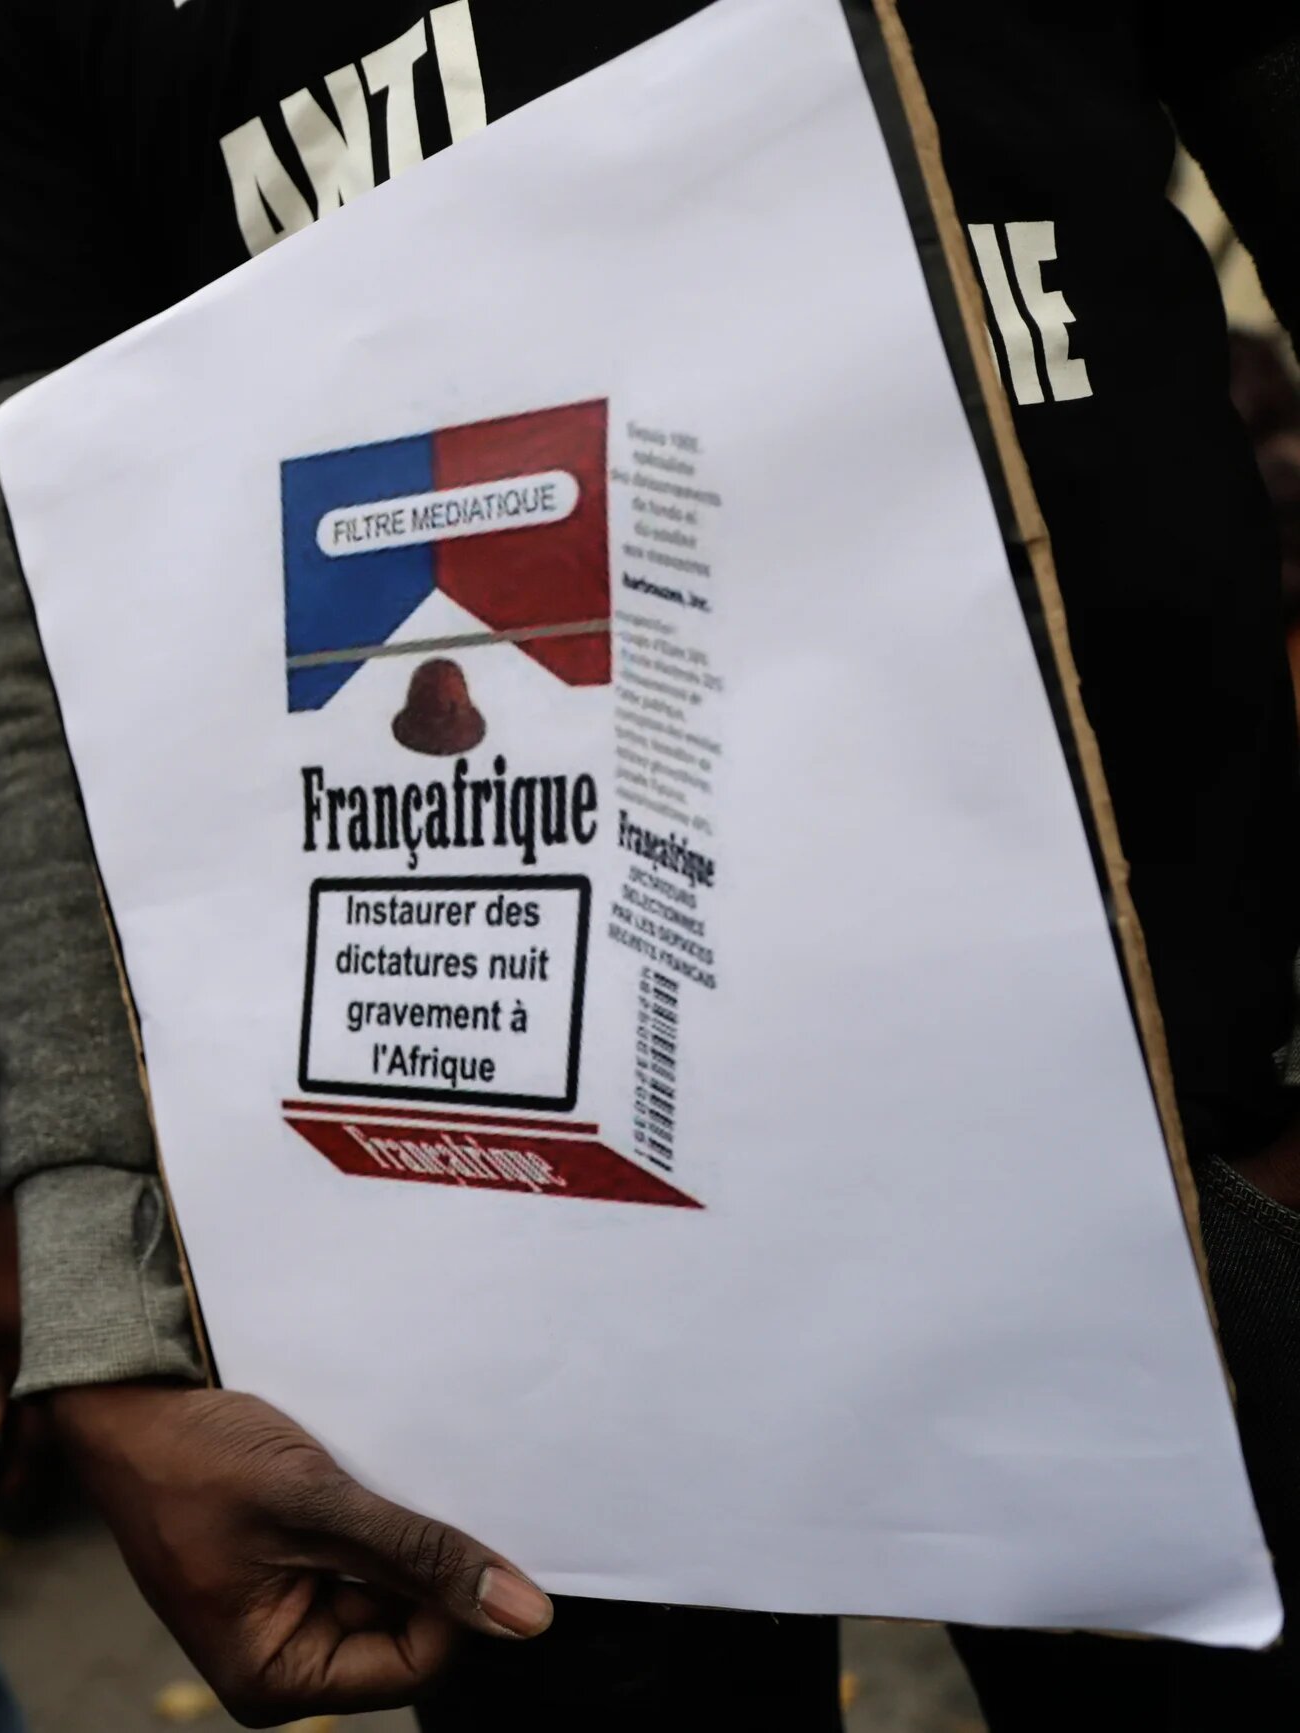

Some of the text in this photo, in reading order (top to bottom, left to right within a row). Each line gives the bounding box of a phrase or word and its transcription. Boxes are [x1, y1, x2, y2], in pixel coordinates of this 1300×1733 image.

[219, 0, 487, 258] ANTI
[967, 220, 1094, 406] IE
[332, 507, 407, 545] FILTRE
[411, 482, 558, 533] MEDIATIQUE
[301, 755, 598, 869] Françafrique
[618, 809, 715, 888] Françafrique
[345, 894, 541, 928] Instaurer des
[336, 944, 549, 981] dictatures nuit
[347, 1000, 529, 1033] gravement à
[373, 1043, 497, 1088] l'Afrique
[343, 1123, 567, 1192] Françafrique
